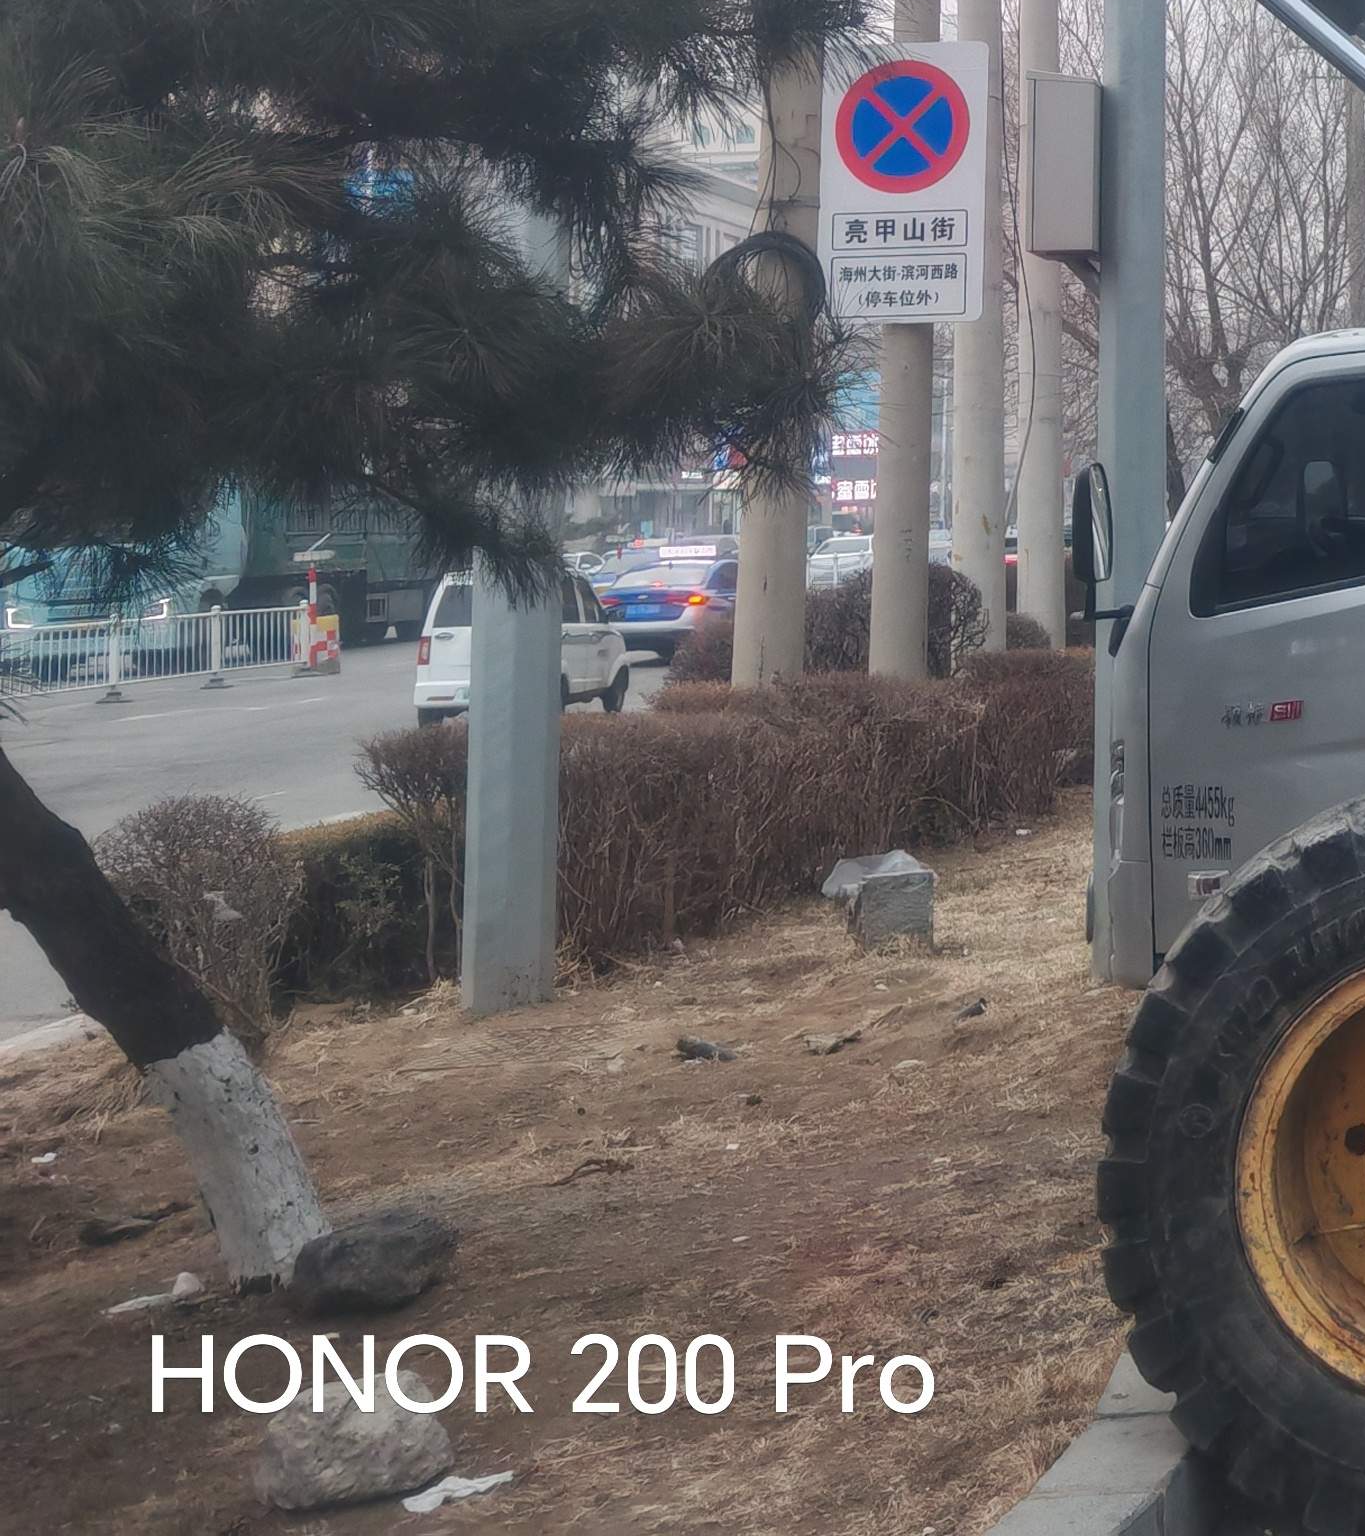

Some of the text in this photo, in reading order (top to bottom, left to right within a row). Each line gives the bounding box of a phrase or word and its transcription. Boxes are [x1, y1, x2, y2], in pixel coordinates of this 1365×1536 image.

[845, 217, 955, 245] 亮甲山街
[1161, 784, 1235, 827] 总质量4455kg
[1161, 825, 1232, 861] 栏板高360mm
